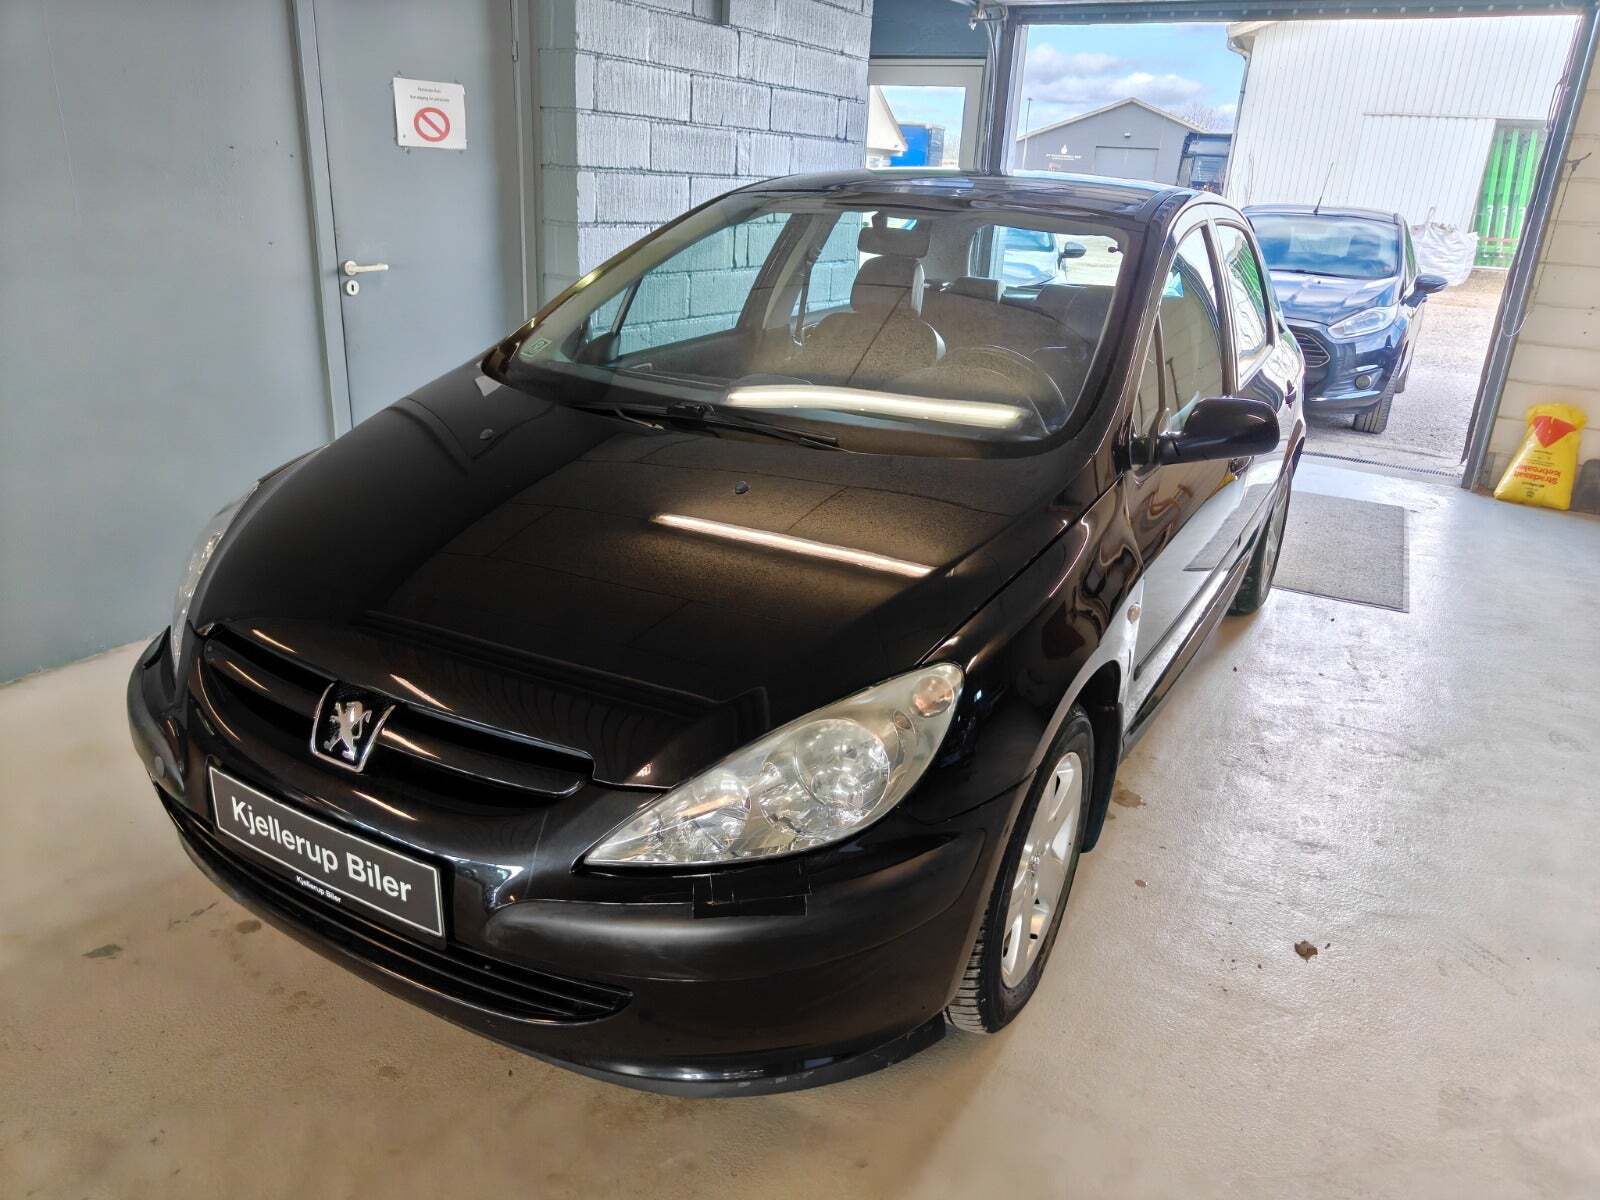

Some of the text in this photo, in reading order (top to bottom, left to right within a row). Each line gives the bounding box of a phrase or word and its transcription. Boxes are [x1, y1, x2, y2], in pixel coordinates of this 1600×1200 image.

[231, 796, 412, 902] Kjellerup Biler
[296, 875, 341, 903] Kjellerup Biler
